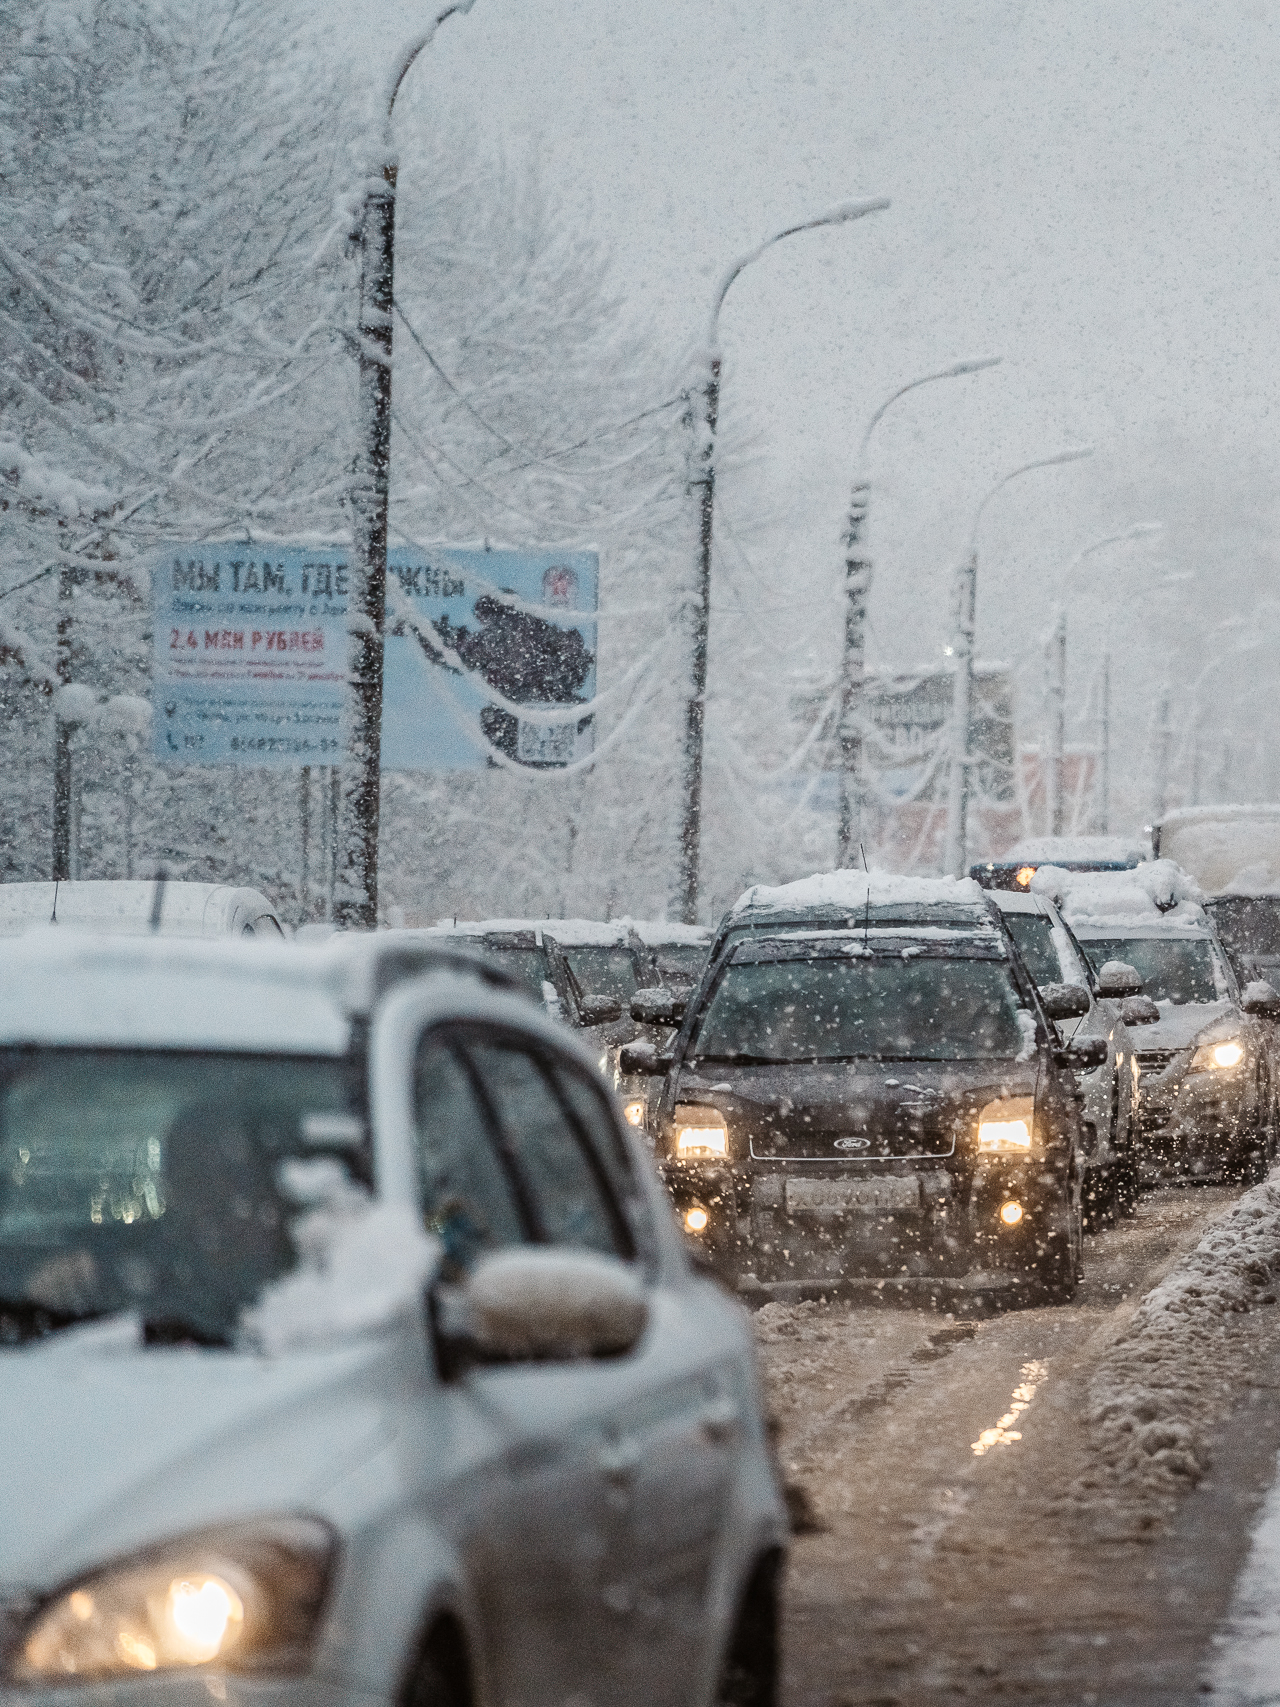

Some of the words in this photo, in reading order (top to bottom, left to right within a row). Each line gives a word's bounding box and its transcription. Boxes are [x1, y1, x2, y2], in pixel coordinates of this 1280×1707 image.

[173, 559, 221, 592] МЫ
[230, 560, 292, 597] ТАМ,
[302, 562, 349, 600] ГДЕ
[204, 629, 244, 650] МЛН
[252, 626, 324, 652] РУБЛЕЙ
